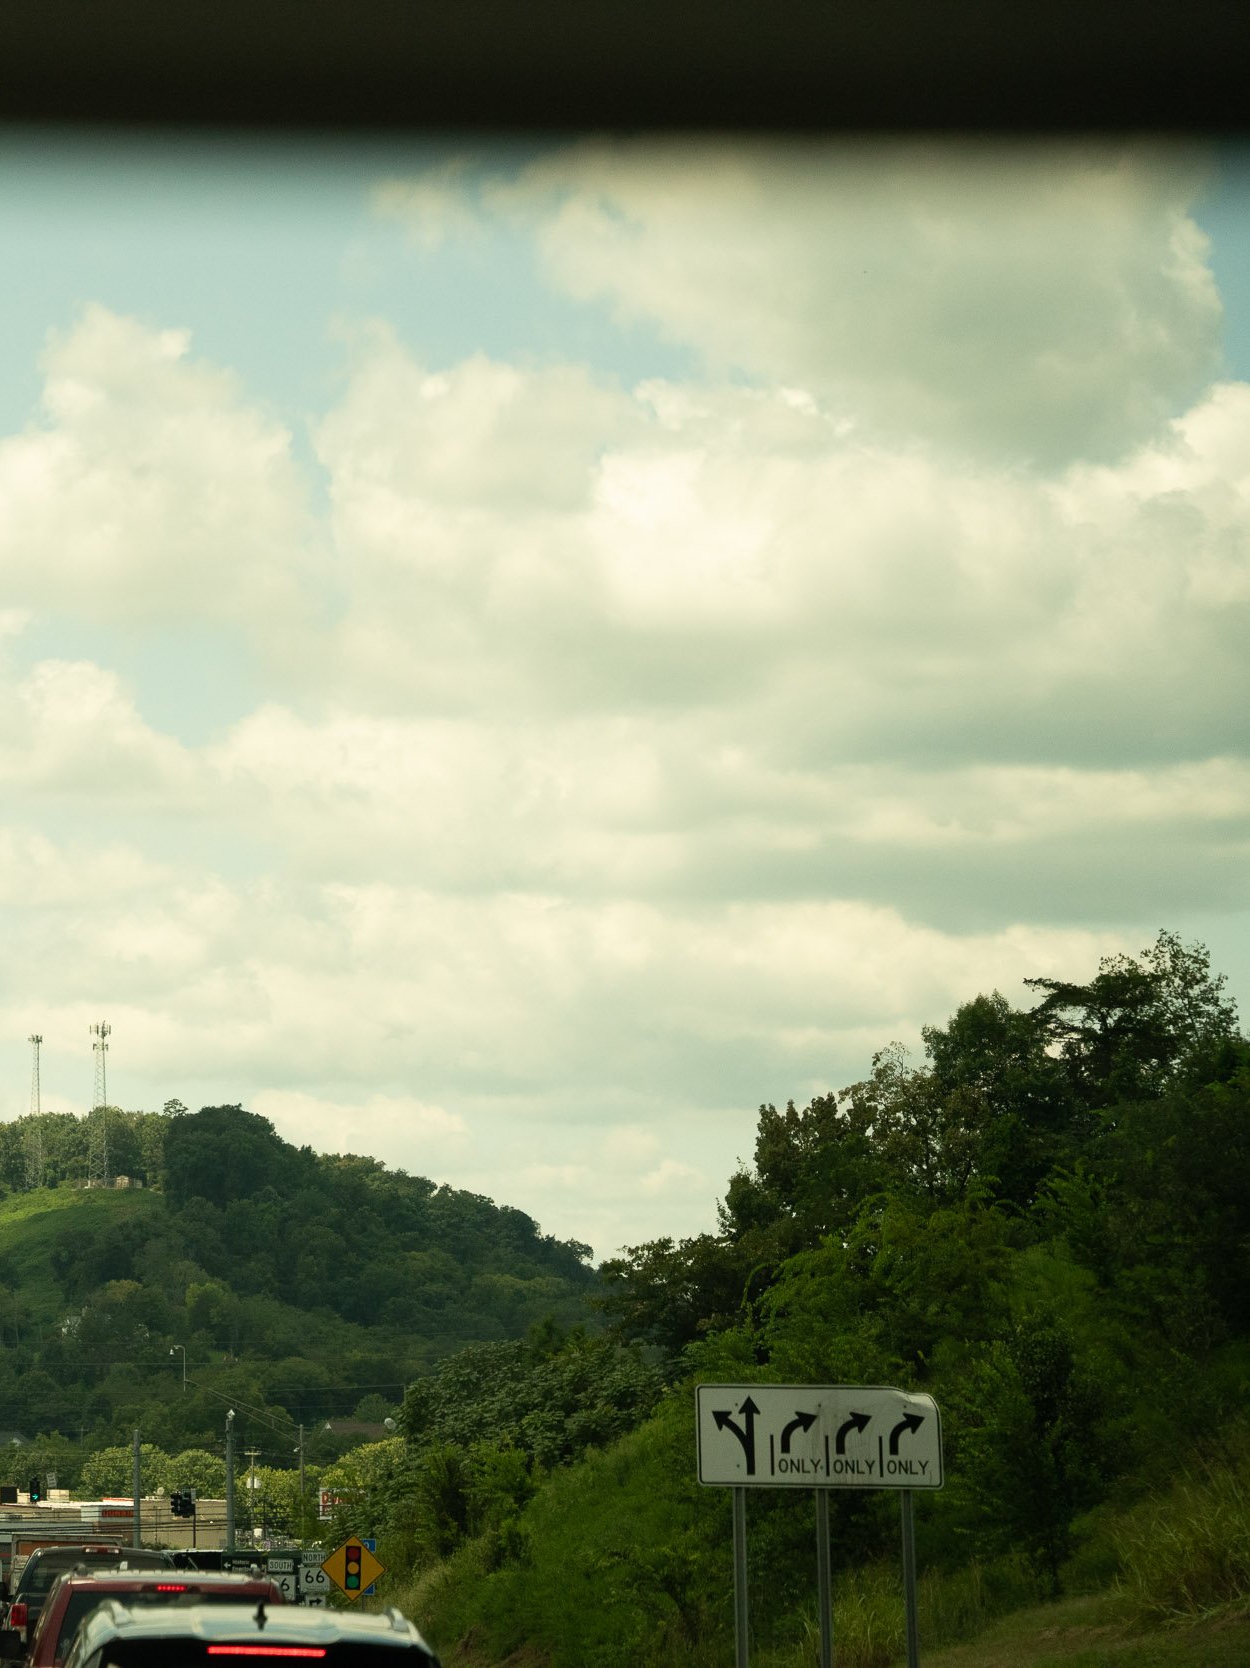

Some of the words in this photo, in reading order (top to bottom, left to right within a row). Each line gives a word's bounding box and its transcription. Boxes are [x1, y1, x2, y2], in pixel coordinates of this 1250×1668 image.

[778, 1458, 821, 1474] ONLY
[833, 1459, 875, 1475] ONLY
[886, 1460, 929, 1476] ONLY
[303, 1553, 325, 1562] NORTH
[269, 1561, 292, 1569] SOUTH
[305, 1570, 325, 1584] 66
